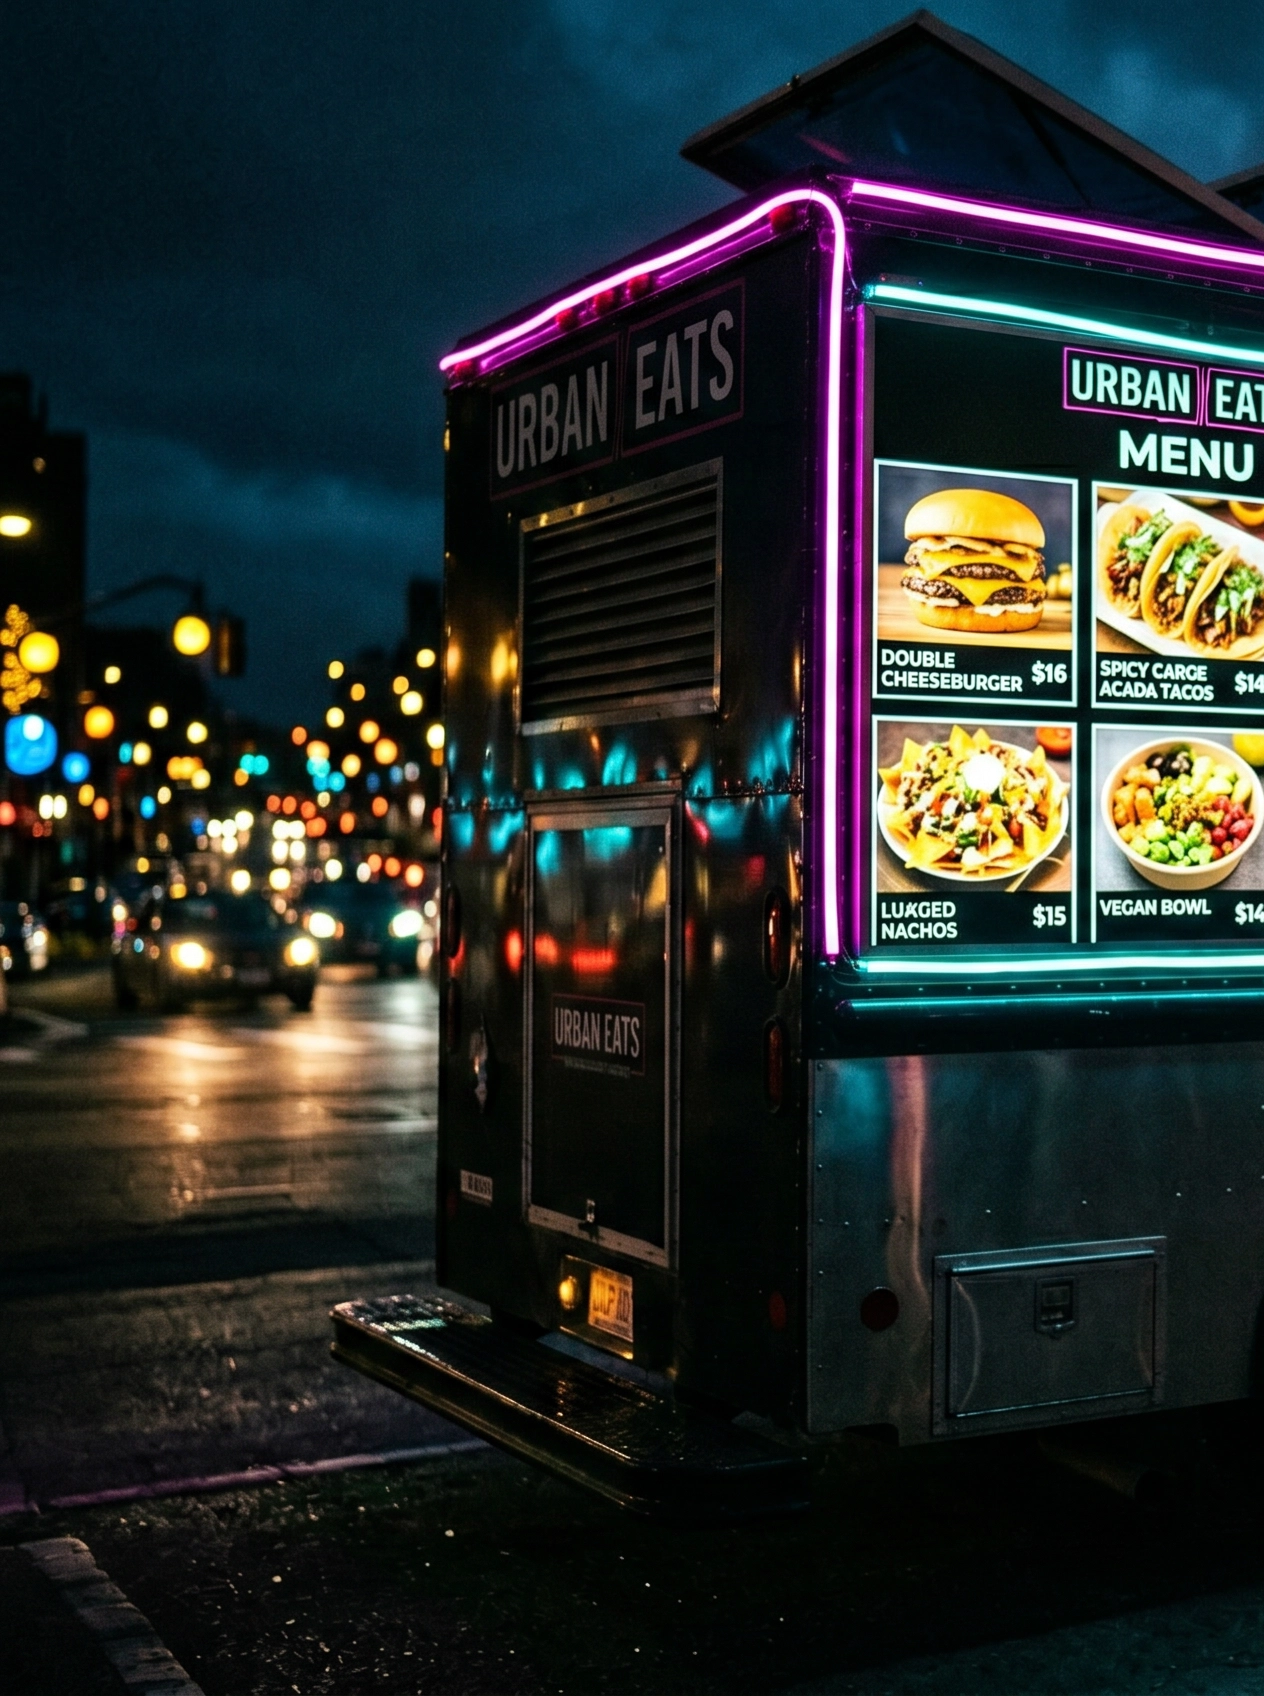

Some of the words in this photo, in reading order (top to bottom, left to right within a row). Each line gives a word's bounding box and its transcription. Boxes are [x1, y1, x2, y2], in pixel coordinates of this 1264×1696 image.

[496, 361, 608, 478] URBAN
[635, 309, 734, 429] EATS
[1071, 358, 1190, 414] URBAN
[1119, 430, 1255, 481] MENU
[881, 649, 956, 669] DOUBLE
[1100, 659, 1149, 678] SPICY
[881, 670, 1023, 692] CHEESEBURGER
[1031, 660, 1068, 685] $16
[1099, 681, 1157, 698] ACADA
[1159, 683, 1215, 701] TACOS
[1032, 904, 1067, 928] $15
[1099, 899, 1158, 917] VEGAN
[1161, 898, 1212, 916] BOWL
[881, 921, 958, 940] NACHOS
[554, 1007, 600, 1051] URBAN
[604, 1014, 640, 1058] EATS
